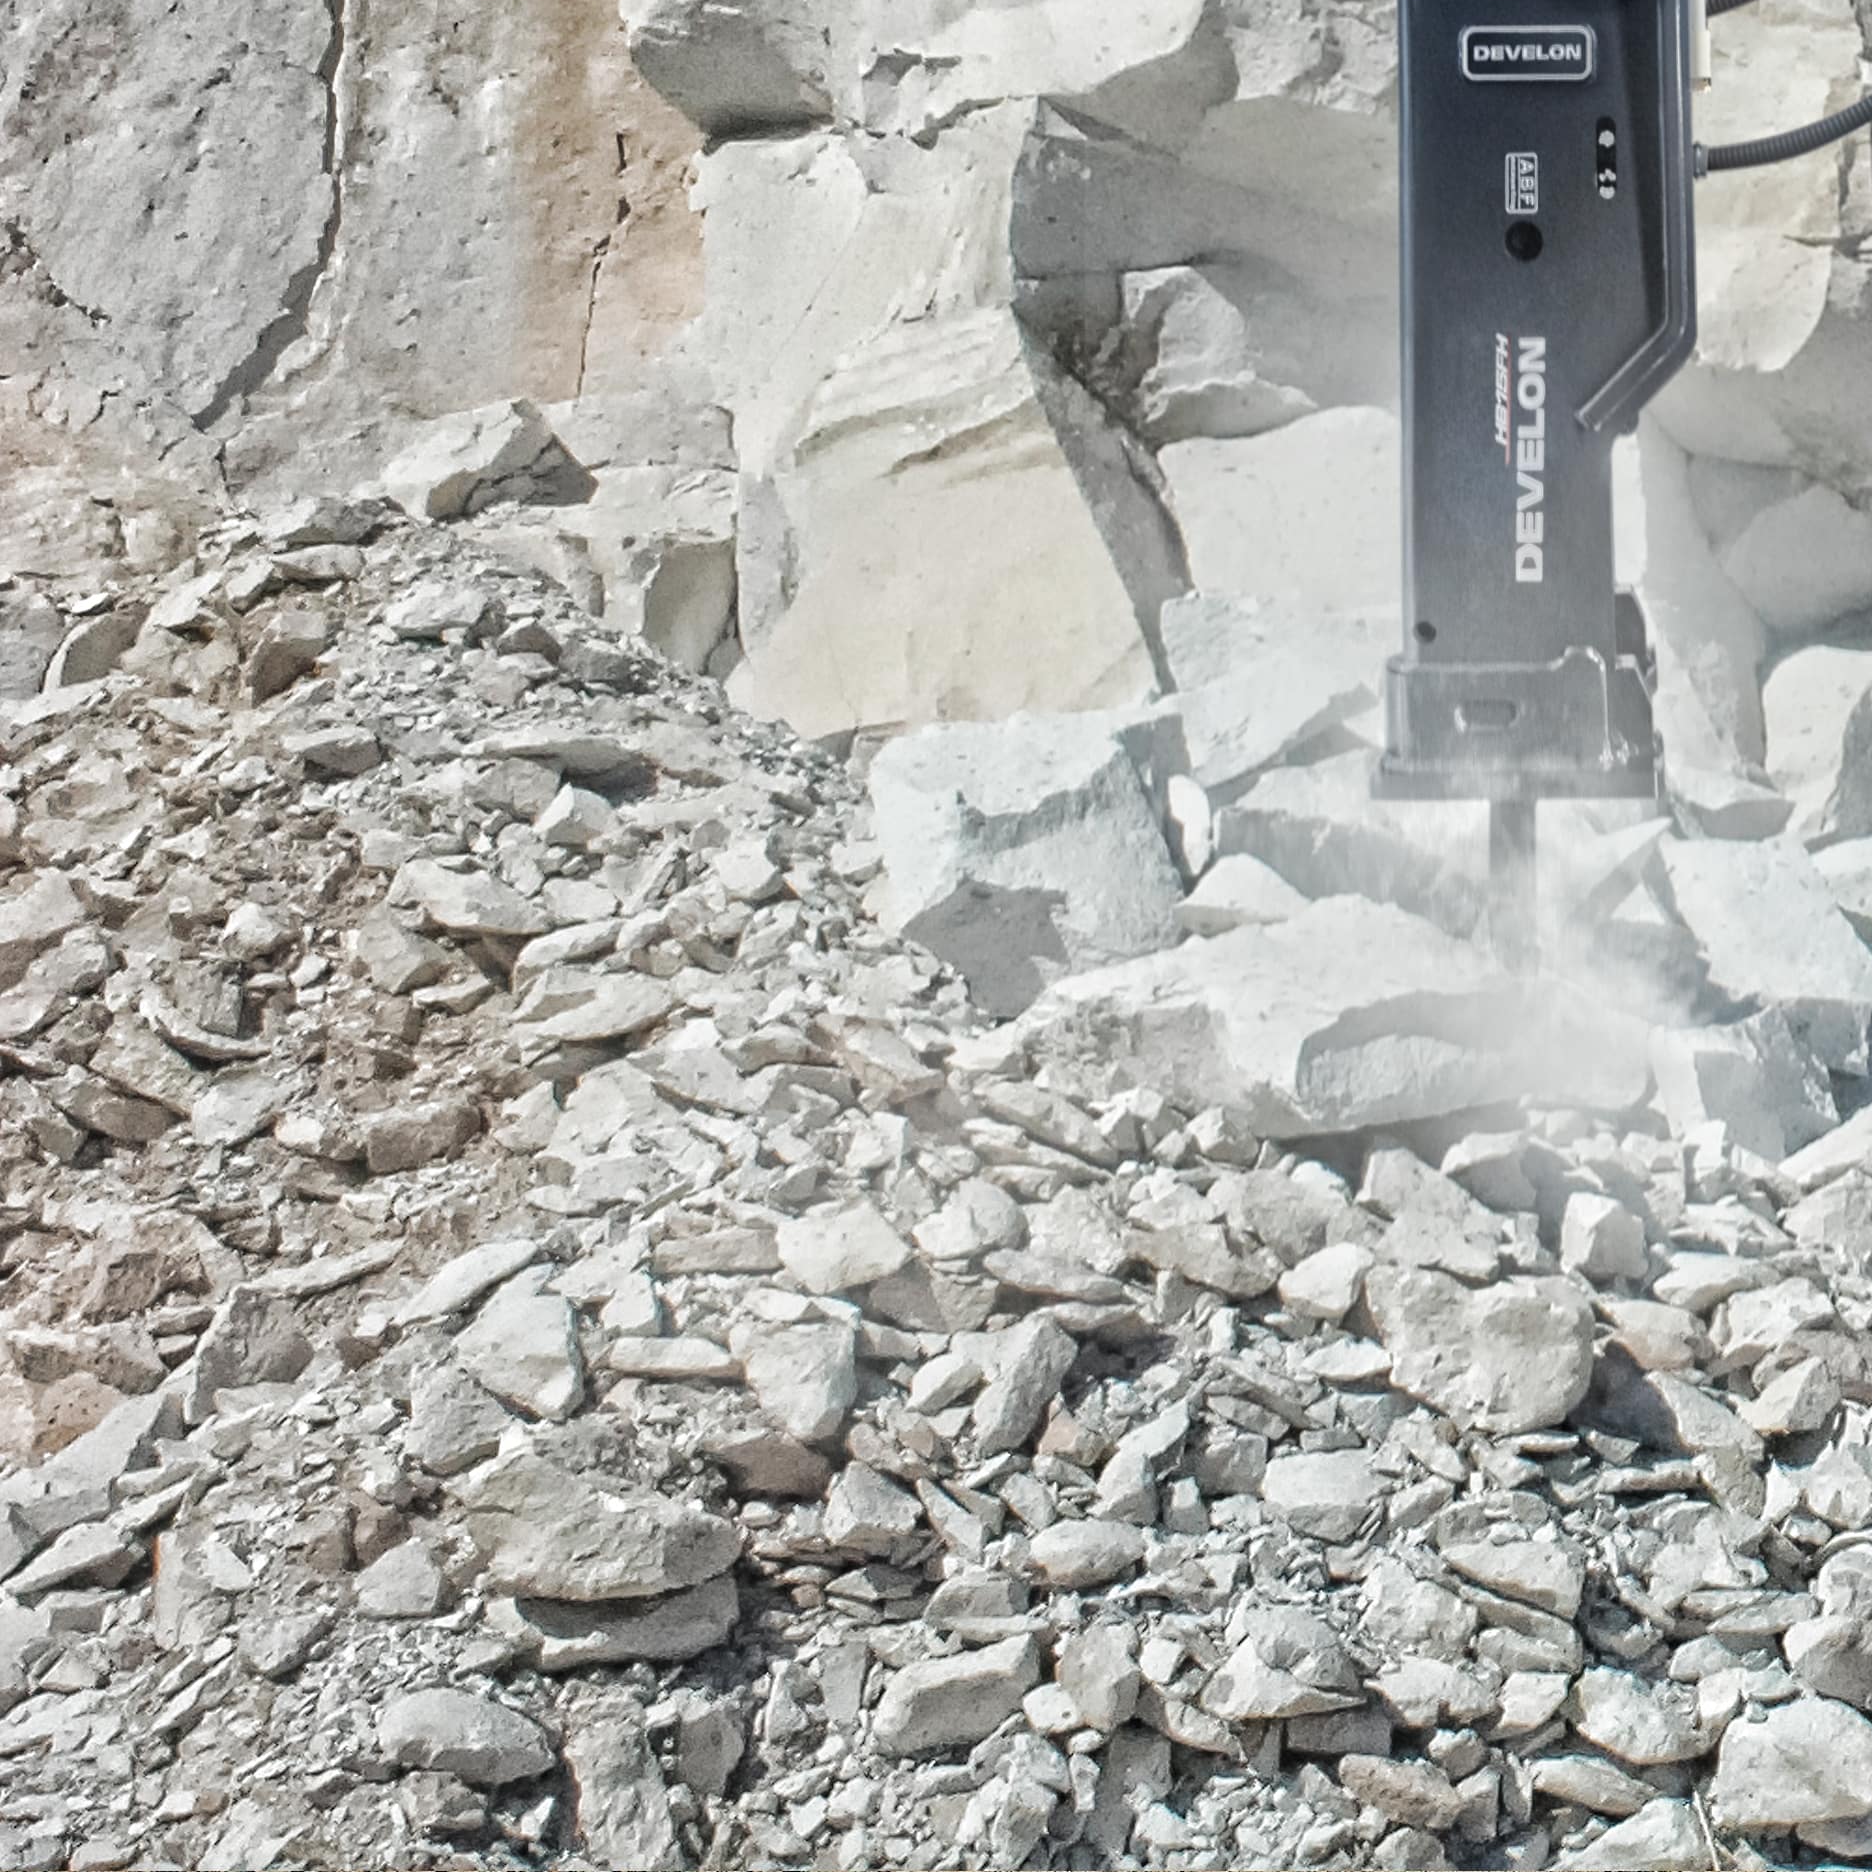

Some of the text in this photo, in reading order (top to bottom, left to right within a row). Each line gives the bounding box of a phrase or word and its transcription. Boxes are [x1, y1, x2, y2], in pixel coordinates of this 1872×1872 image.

[1473, 44, 1582, 61] DEVELON
[1519, 159, 1535, 206] ABF
[1495, 332, 1509, 447] HB15FH
[1515, 336, 1546, 582] DEVELON
